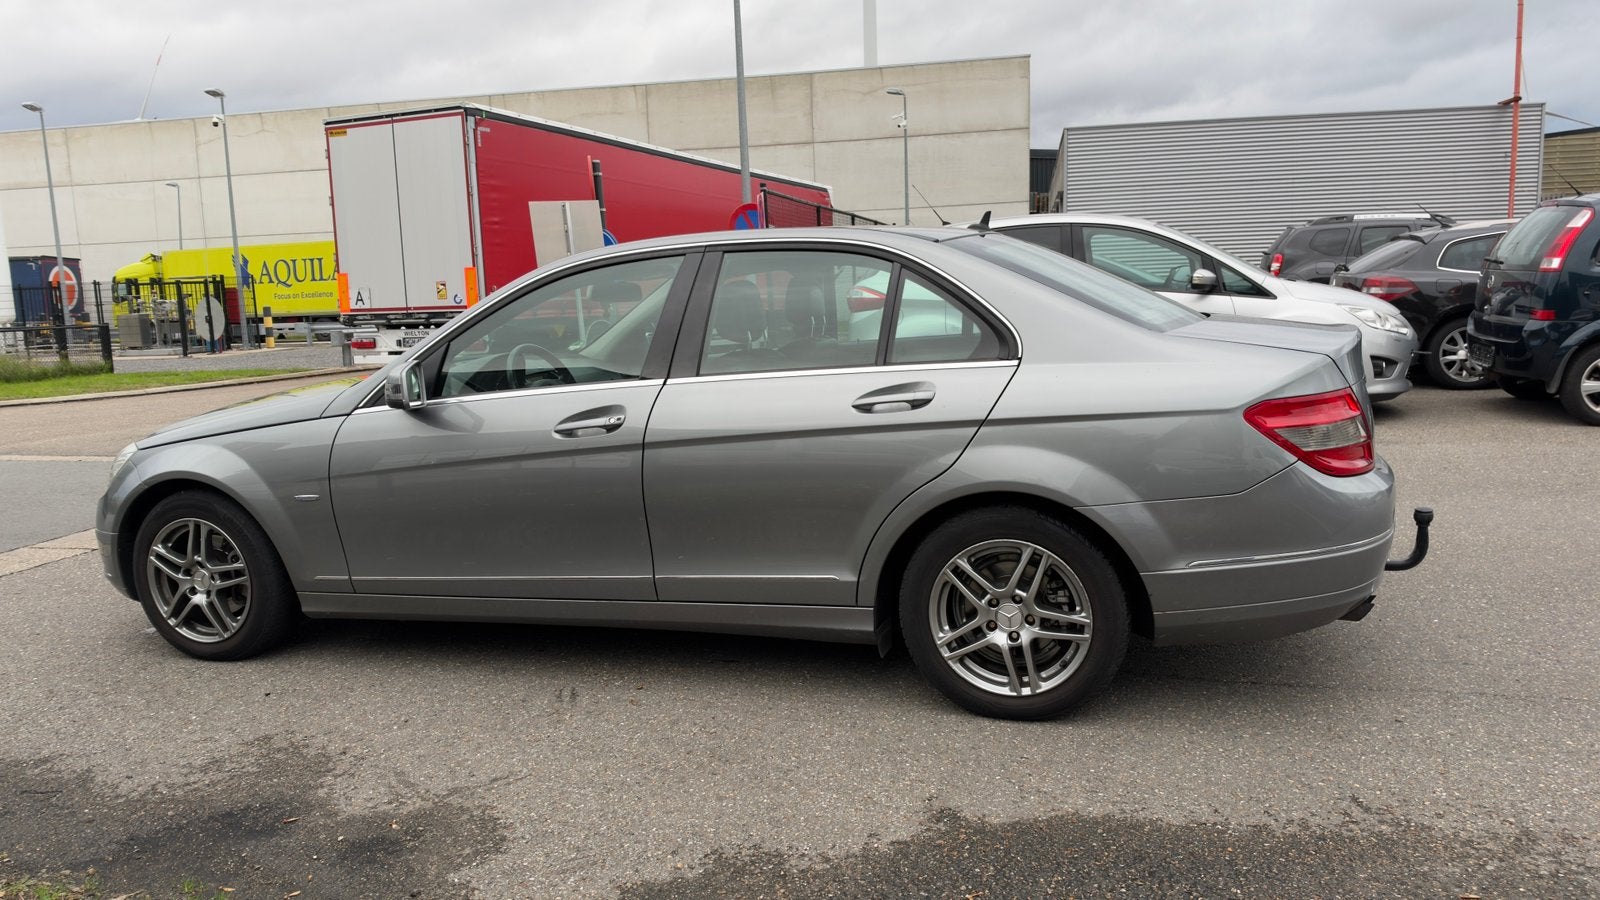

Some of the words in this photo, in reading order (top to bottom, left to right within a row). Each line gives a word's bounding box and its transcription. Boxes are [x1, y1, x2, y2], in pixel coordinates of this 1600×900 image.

[273, 292, 291, 300] Focus
[301, 290, 334, 299] Excellence
[355, 290, 365, 306] A
